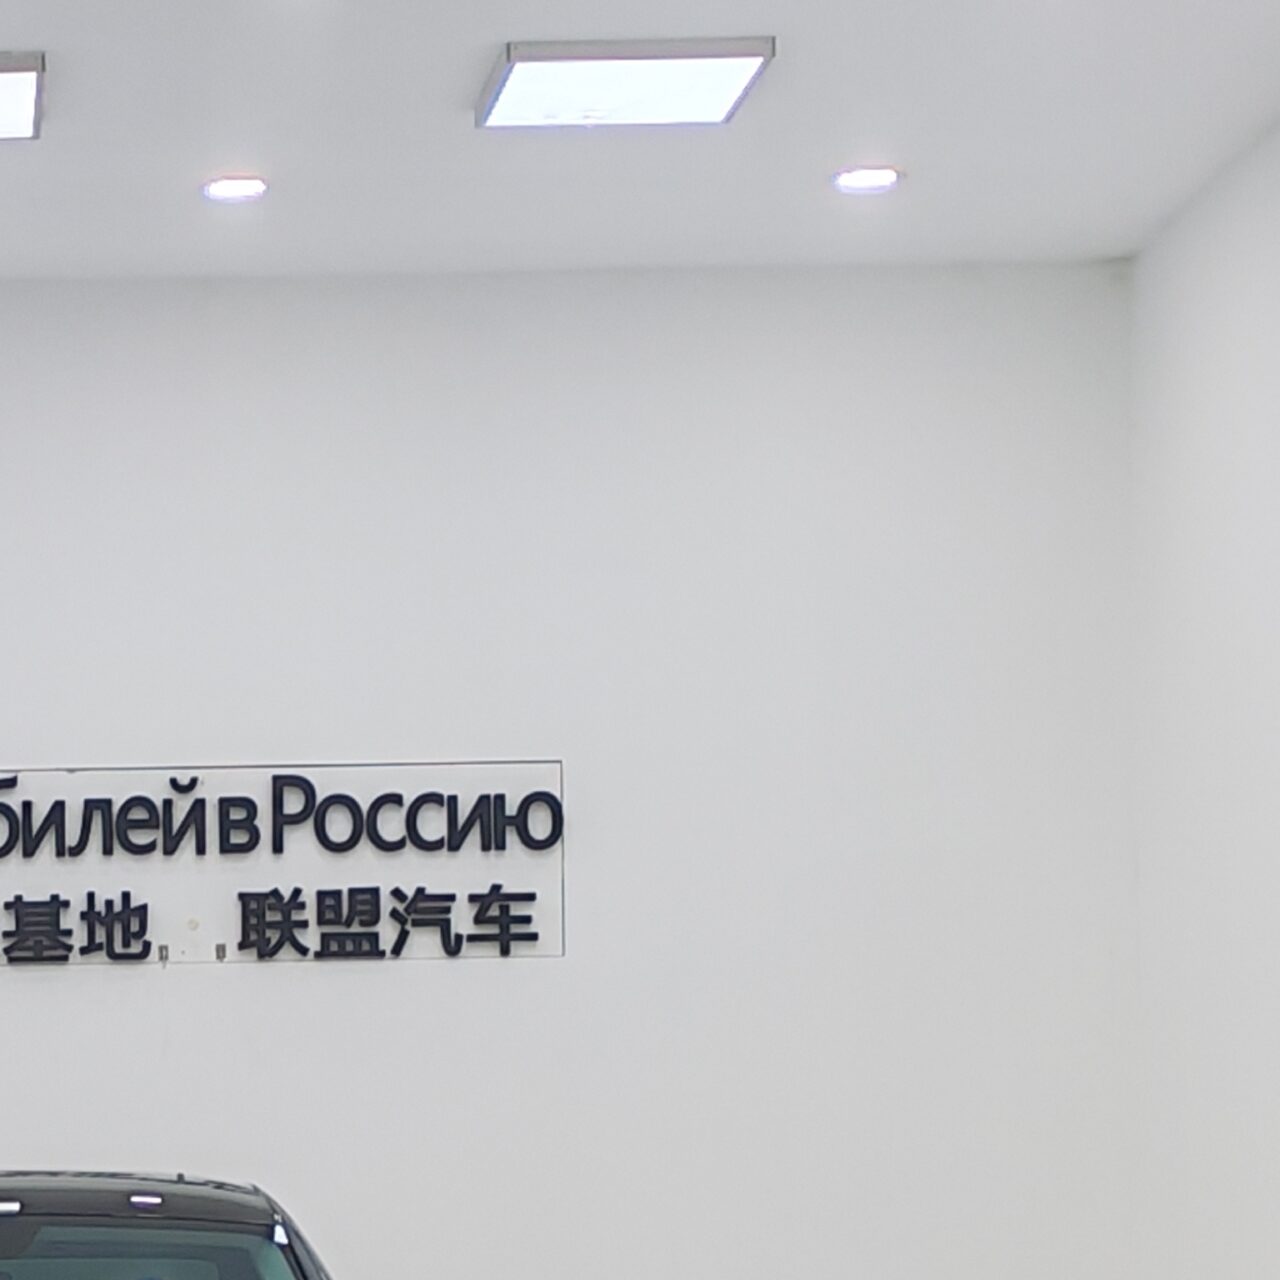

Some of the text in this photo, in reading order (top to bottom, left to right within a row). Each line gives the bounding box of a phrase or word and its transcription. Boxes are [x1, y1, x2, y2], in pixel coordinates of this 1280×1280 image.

[218, 796, 261, 854] в
[271, 774, 564, 855] Россию
[237, 883, 540, 959] 联盟汽车
